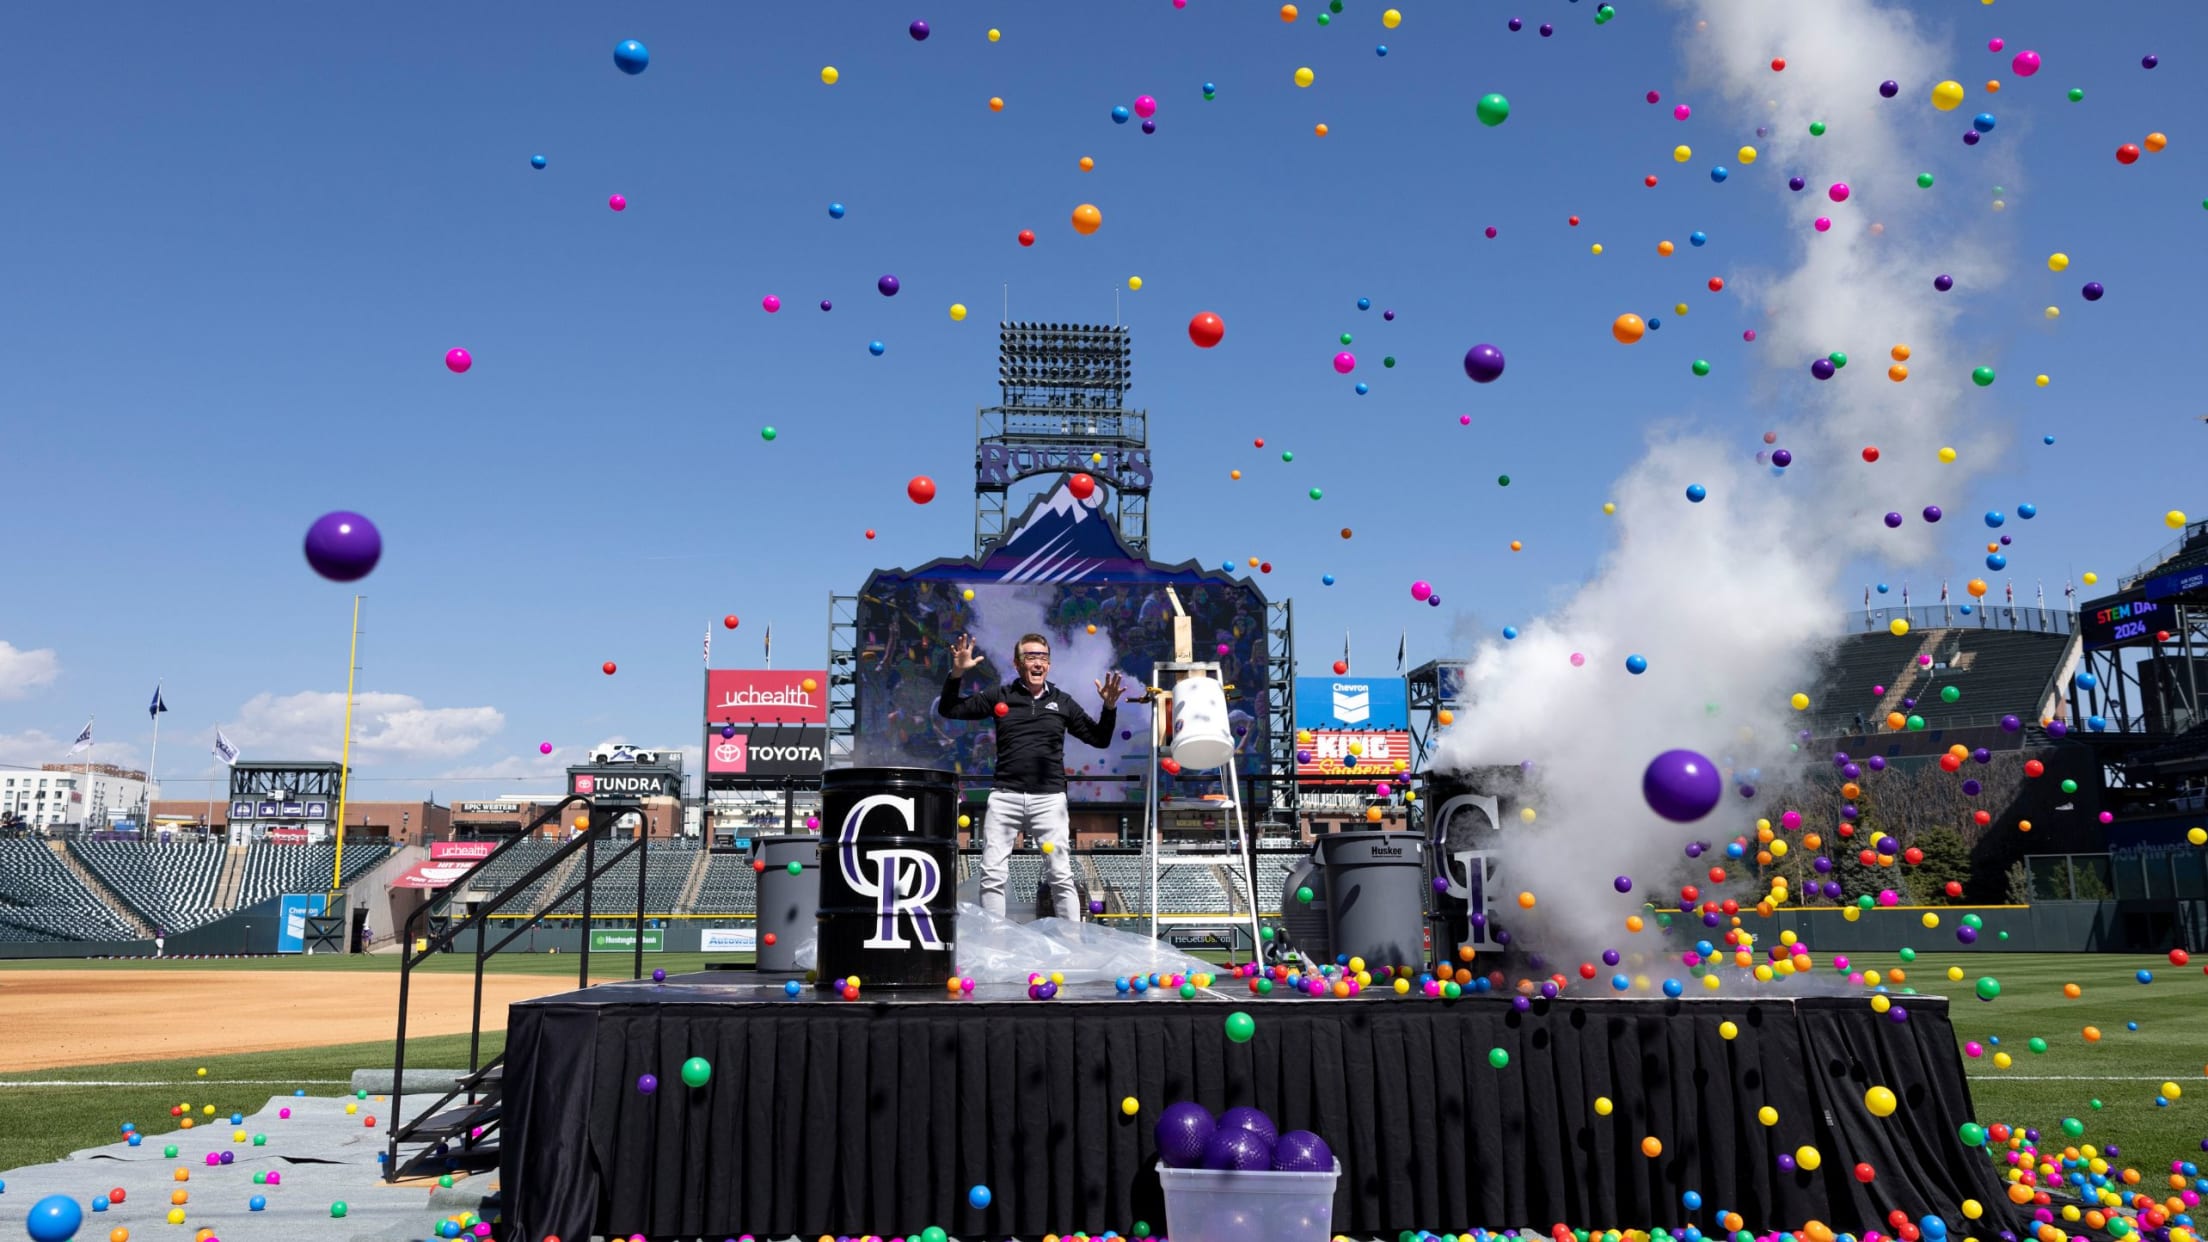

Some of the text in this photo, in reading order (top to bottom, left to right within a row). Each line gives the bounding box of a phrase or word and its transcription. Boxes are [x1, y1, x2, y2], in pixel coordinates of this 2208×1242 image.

[977, 445, 1154, 489] ROCKIES
[2096, 603, 2131, 625] STEM
[2113, 620, 2147, 640] 2024
[1332, 683, 1369, 692] Chevron
[725, 684, 810, 707] uchealth
[748, 746, 822, 761] TOYOTA
[1317, 736, 1390, 759] KING
[594, 777, 661, 791] TUNDRA
[442, 844, 488, 857] uchealth
[1371, 846, 1403, 855] Huskee
[2108, 840, 2193, 861] Southwest
[605, 935, 637, 945] Huntingto
[709, 936, 757, 945] Autowas
[1175, 935, 1232, 943] HeGetsUs.om
